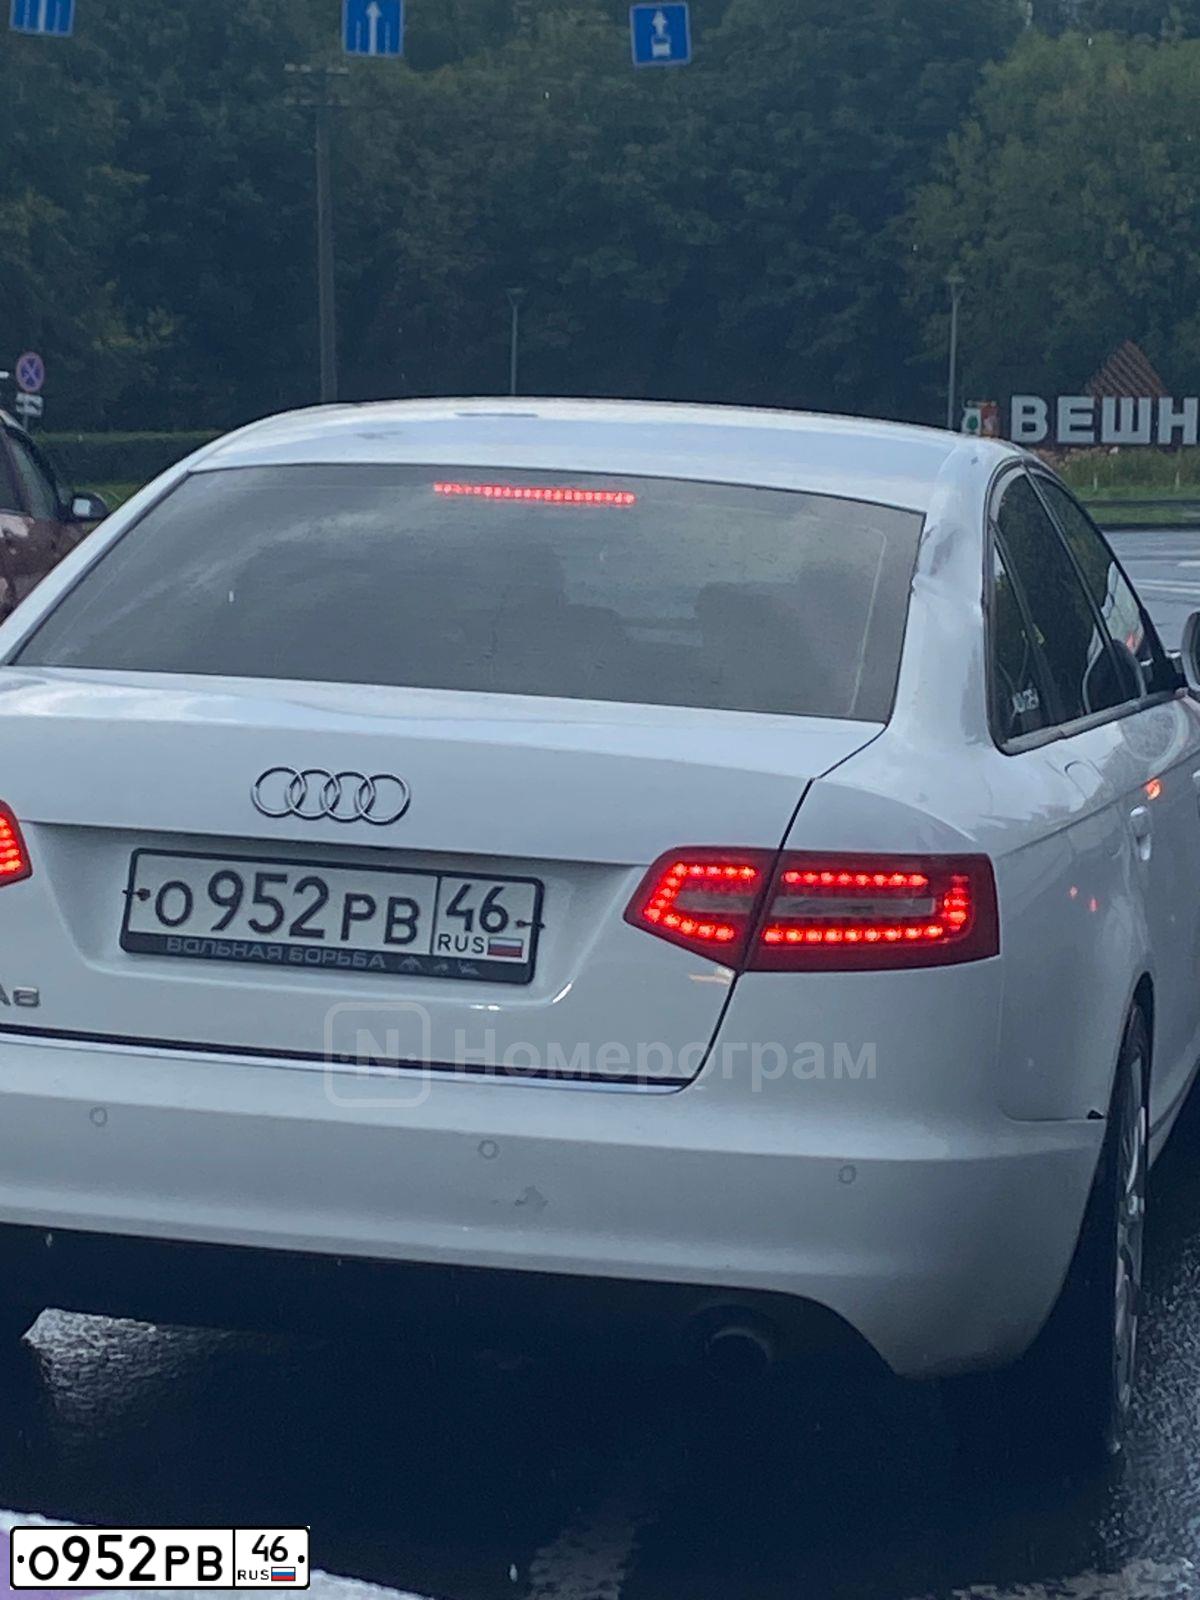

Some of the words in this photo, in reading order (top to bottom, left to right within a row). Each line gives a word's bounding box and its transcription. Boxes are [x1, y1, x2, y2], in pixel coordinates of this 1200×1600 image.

[1010, 395, 1199, 445] ВЕШН
[155, 870, 420, 945] О952РВ
[446, 883, 510, 934] 46
[166, 937, 282, 961] ВОЛЬНАЯ
[288, 948, 387, 970] БОРЬБА
[437, 933, 485, 954] RUS
